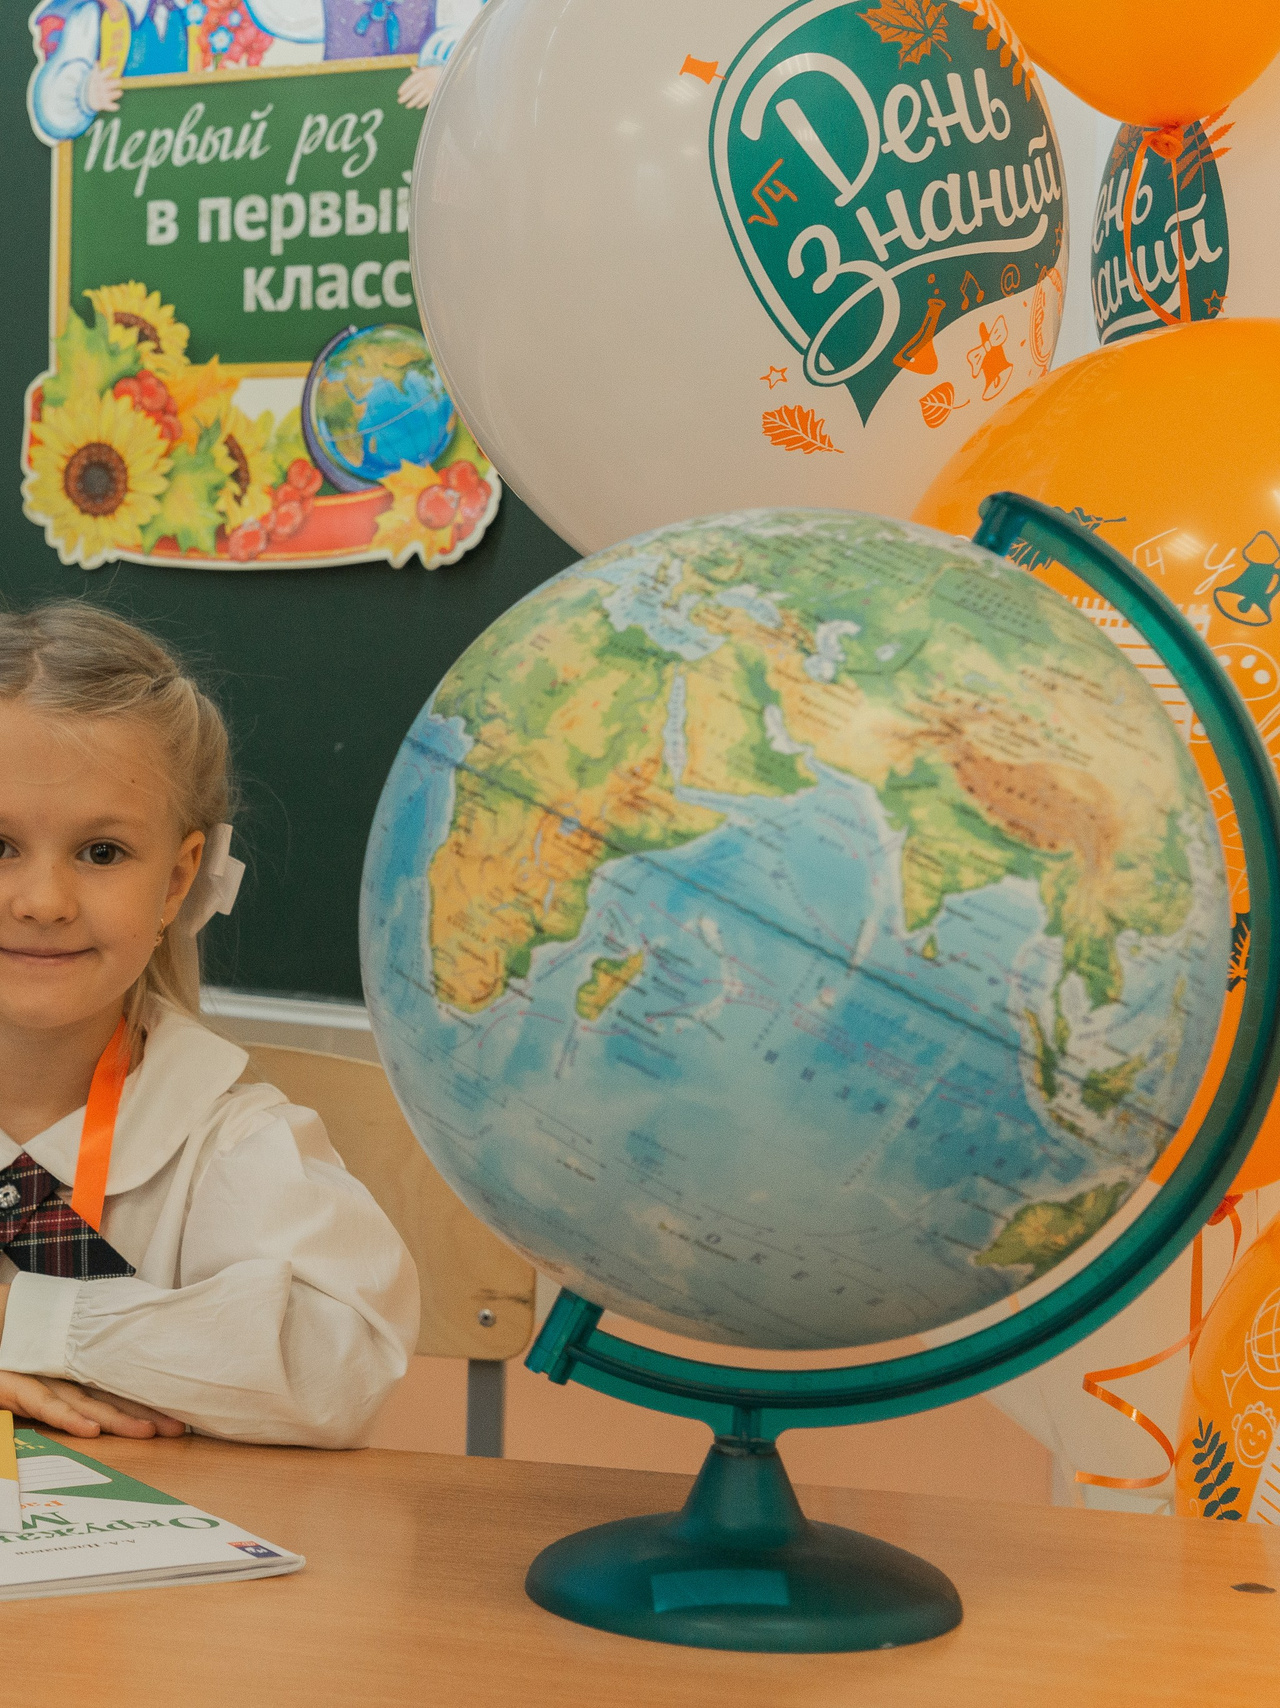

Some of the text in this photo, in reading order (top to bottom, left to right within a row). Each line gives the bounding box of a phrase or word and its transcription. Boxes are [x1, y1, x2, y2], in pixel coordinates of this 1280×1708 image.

[84, 102, 384, 198] Первый раз
[740, 52, 1012, 207] День
[146, 200, 179, 246] в
[1092, 157, 1153, 254] ень
[243, 259, 413, 313] класс
